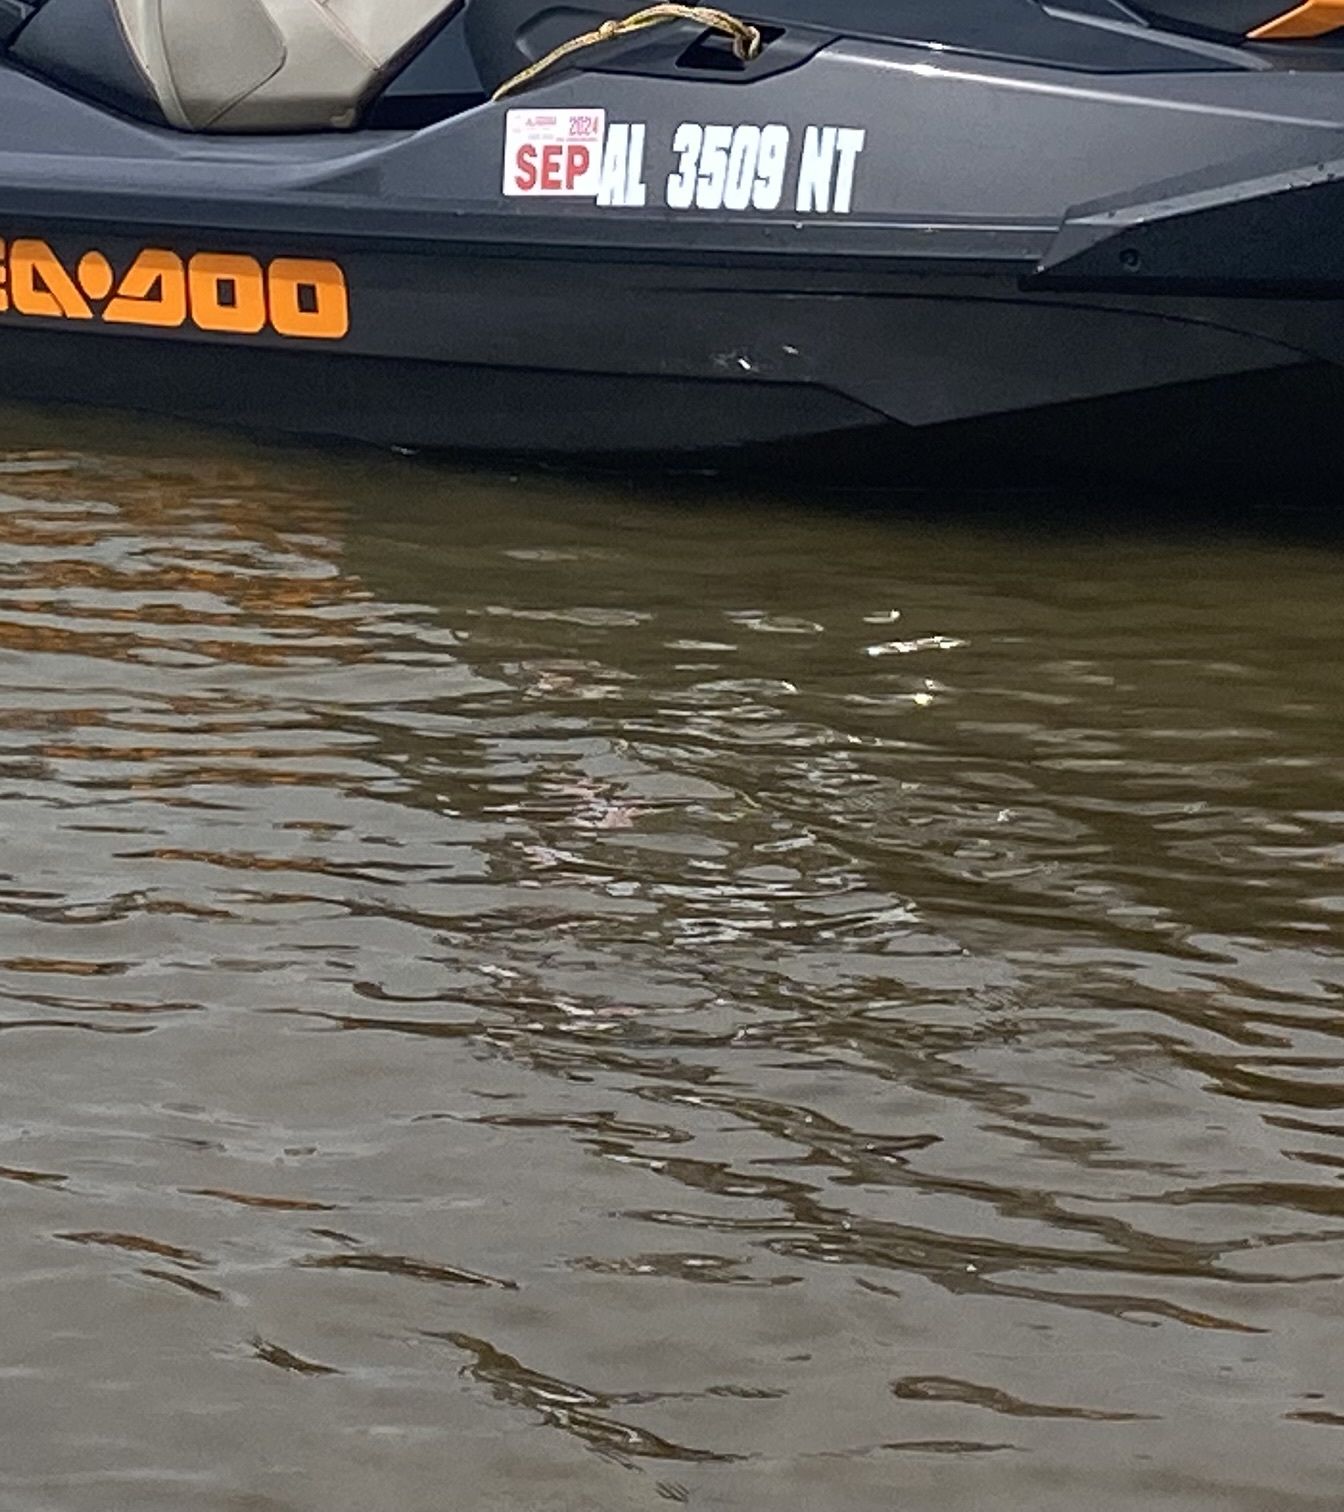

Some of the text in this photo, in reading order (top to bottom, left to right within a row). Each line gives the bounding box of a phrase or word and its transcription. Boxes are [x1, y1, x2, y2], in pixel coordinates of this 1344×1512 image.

[569, 116, 599, 136] 2024
[515, 144, 590, 190] SEP
[596, 123, 866, 213] AL 3509 NT
